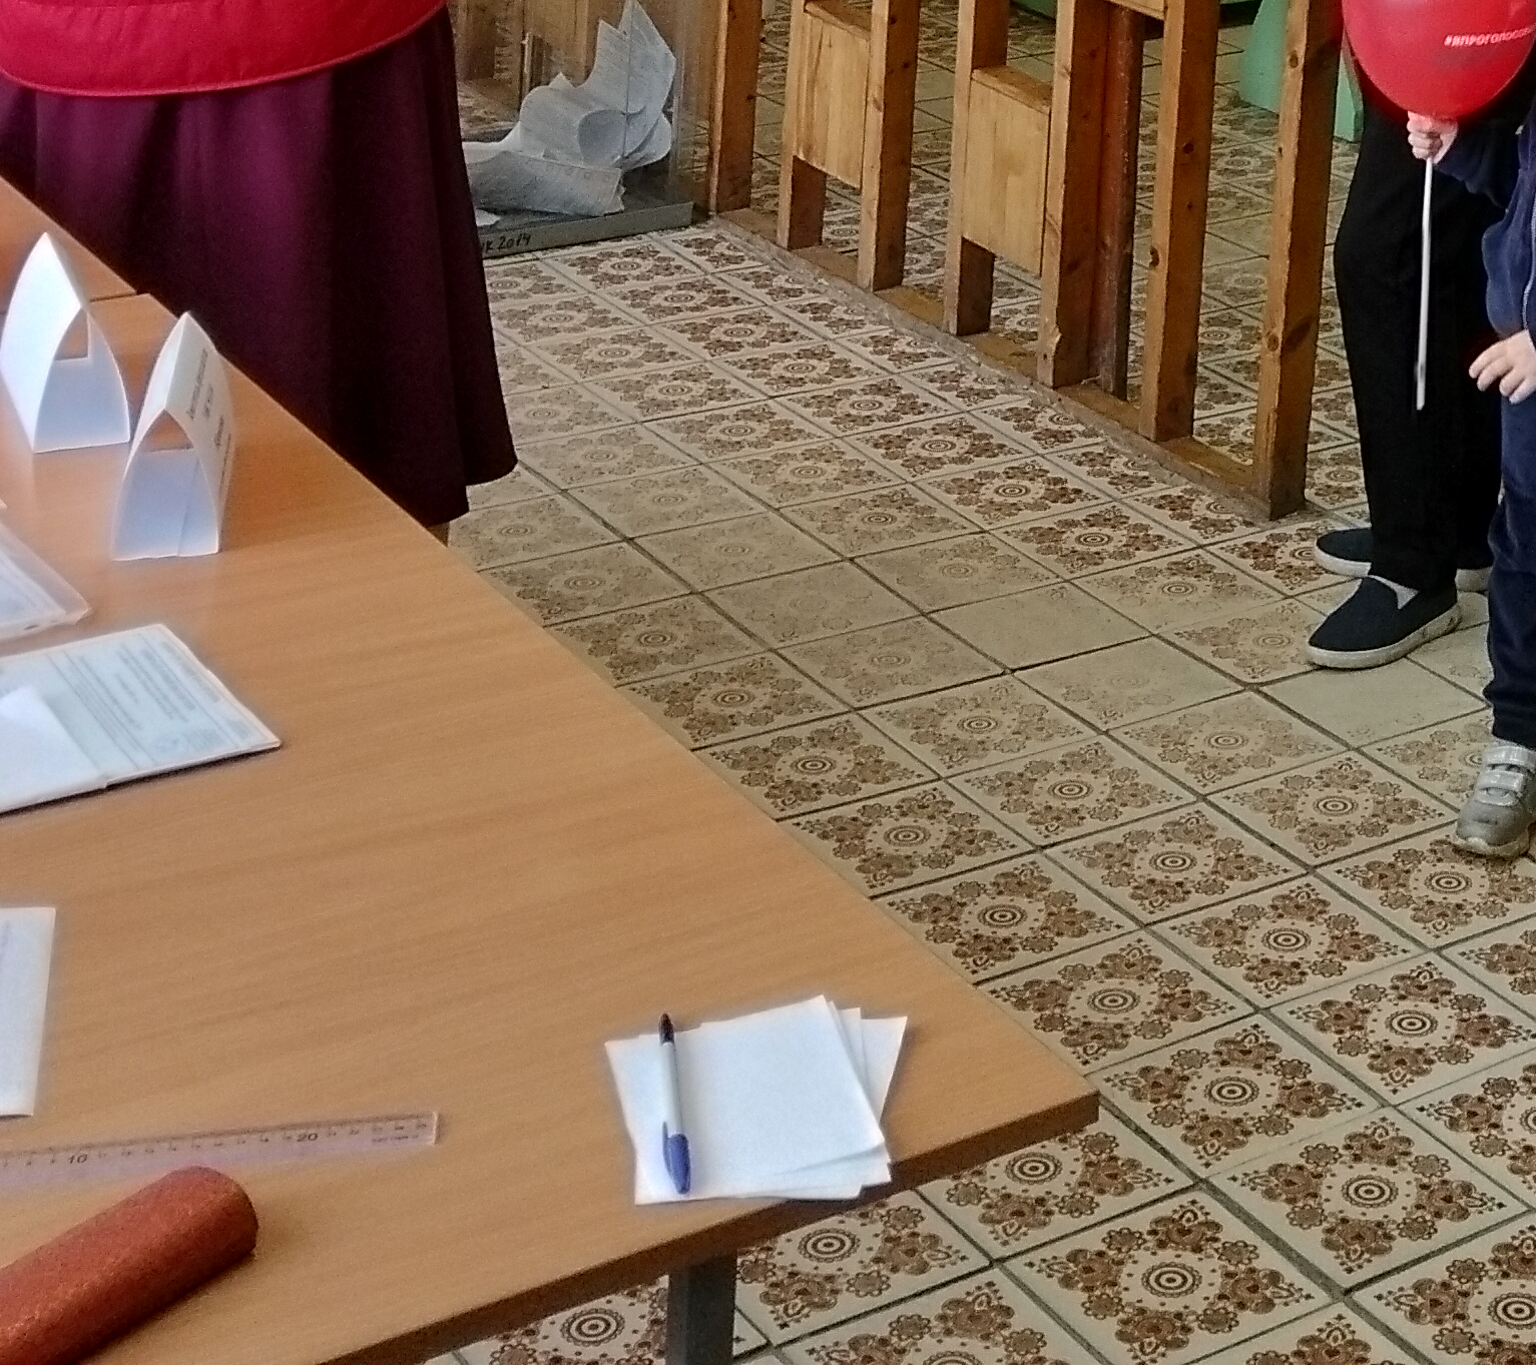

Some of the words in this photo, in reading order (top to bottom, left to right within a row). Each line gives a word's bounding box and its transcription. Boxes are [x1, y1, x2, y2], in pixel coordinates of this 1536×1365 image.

[498, 232, 532, 251] 2014
[69, 1154, 88, 1165] 10
[297, 1132, 318, 1143] 20
